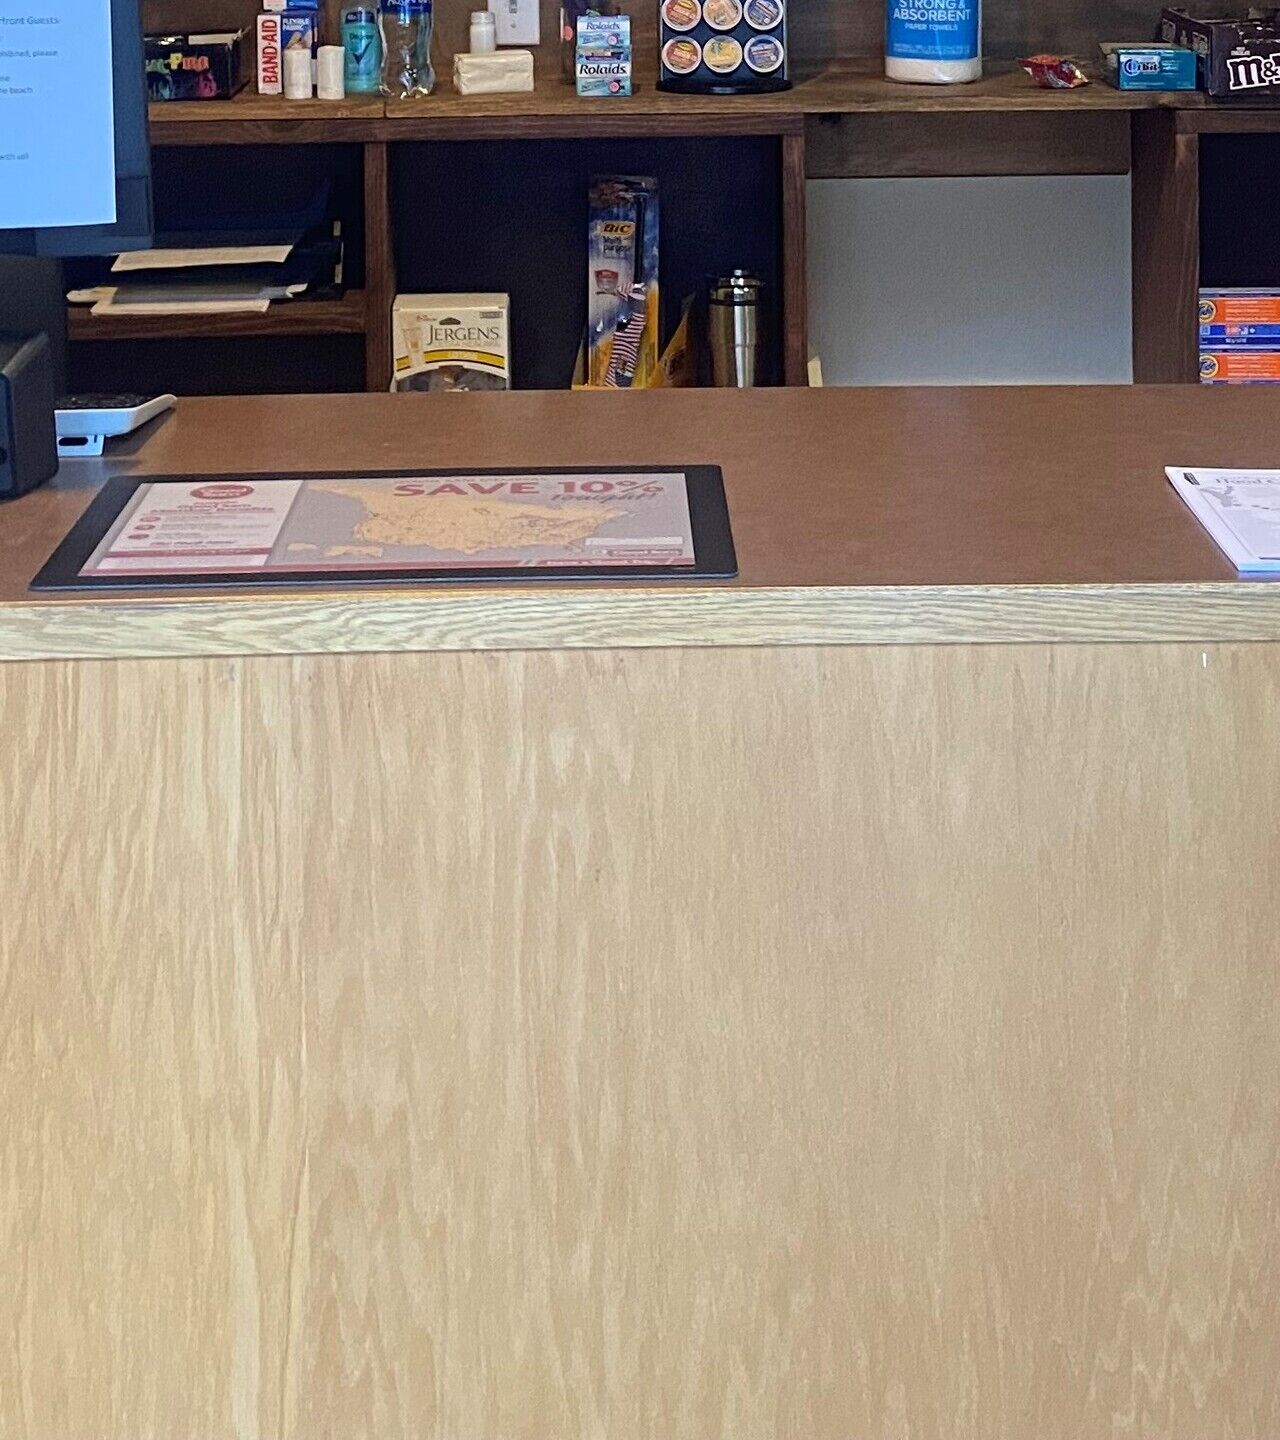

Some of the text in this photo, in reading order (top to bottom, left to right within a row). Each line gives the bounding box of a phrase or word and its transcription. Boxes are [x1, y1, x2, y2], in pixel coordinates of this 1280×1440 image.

[893, 9, 971, 22] ABSORBENT
[586, 22, 620, 31] Rolaids
[261, 19, 278, 84] BAND-AID
[579, 64, 627, 75] Rolaids
[9, 86, 33, 94] beach
[604, 224, 631, 233] BIC
[427, 325, 499, 345] JERGENS
[395, 482, 540, 497] SAVE
[559, 480, 665, 494] 10%
